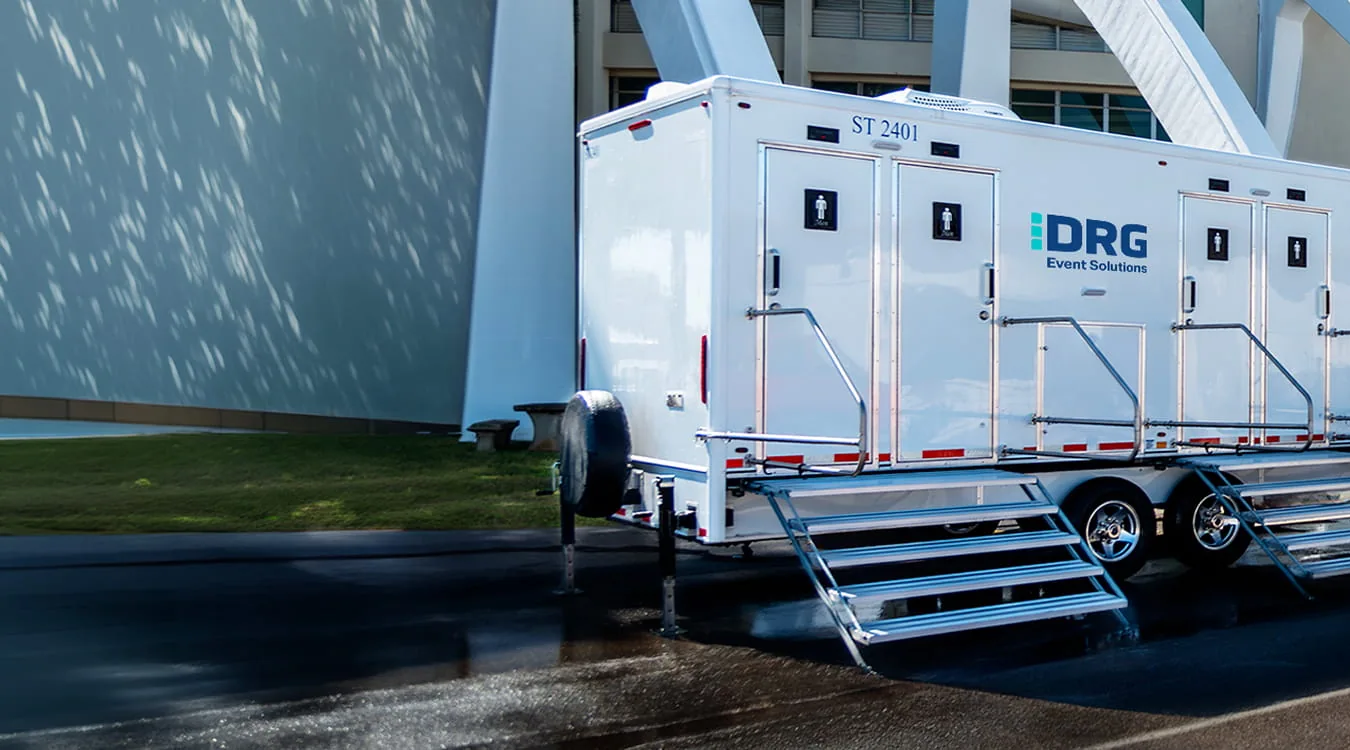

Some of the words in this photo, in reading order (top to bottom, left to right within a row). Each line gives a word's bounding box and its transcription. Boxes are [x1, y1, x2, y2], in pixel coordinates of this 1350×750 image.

[852, 115, 875, 135] ST
[881, 119, 917, 141] 2401
[1047, 214, 1147, 258] DRG
[1047, 257, 1087, 270] Event
[1090, 260, 1147, 273] Solutions
